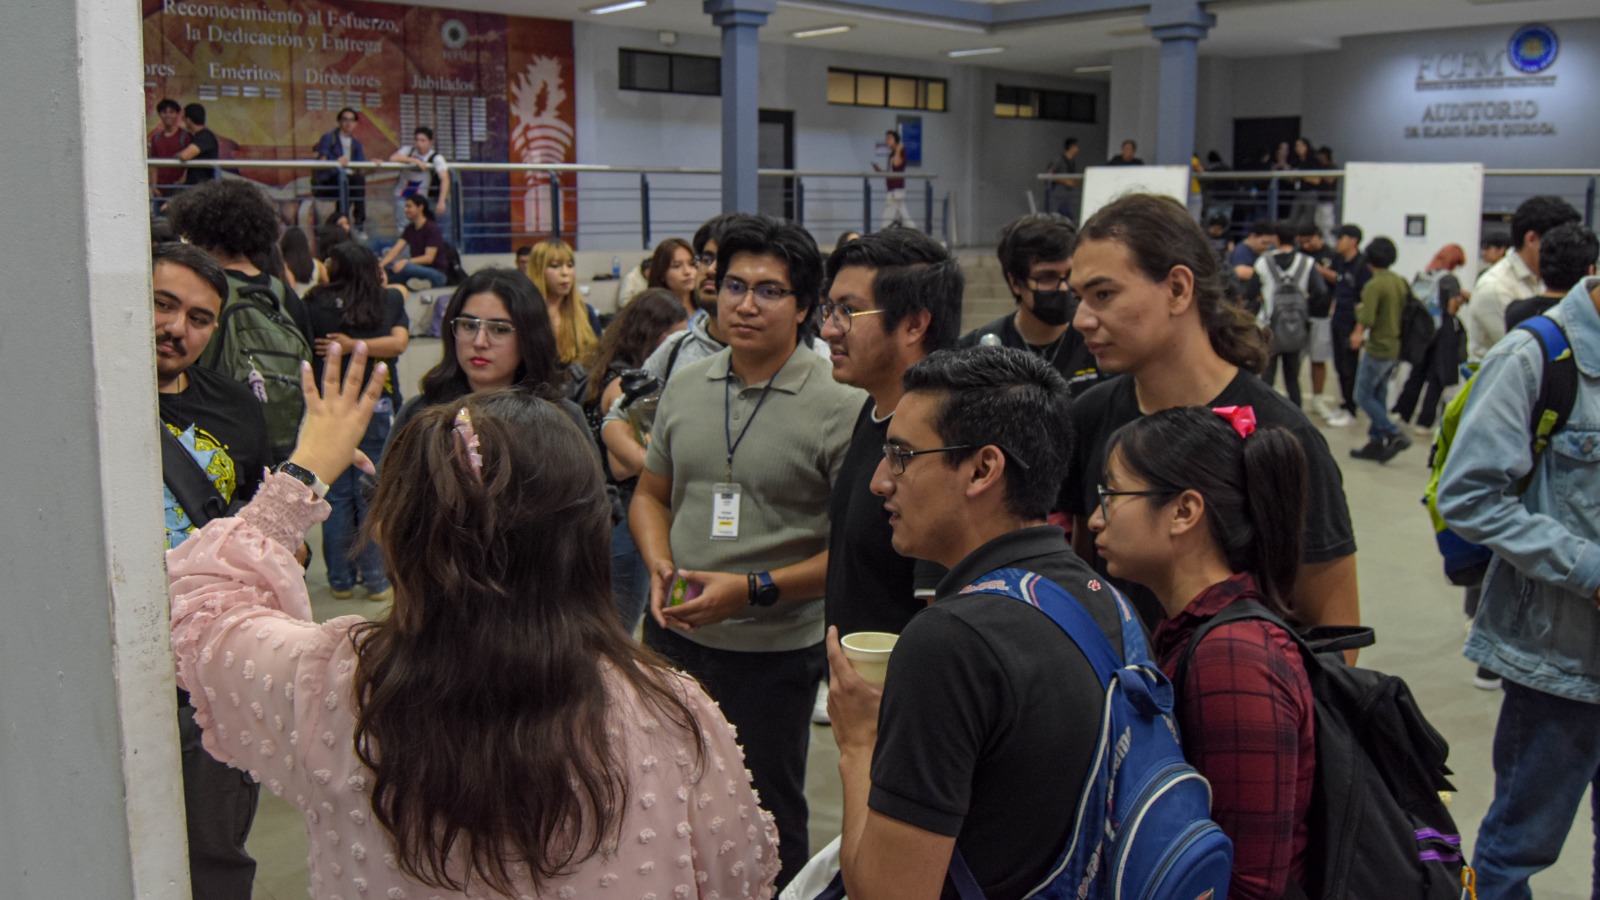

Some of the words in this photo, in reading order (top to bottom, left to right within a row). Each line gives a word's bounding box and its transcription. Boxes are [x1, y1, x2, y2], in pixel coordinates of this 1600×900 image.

[163, 0, 303, 24] Reconocimiento
[307, 10, 321, 25] al
[327, 10, 399, 33] Esfuerzo,
[185, 22, 200, 41] la
[208, 25, 303, 48] Dedicación
[308, 36, 320, 52] y
[322, 33, 382, 57] Entrega
[209, 62, 280, 80] Eméritos
[1415, 50, 1507, 81] FCFM
[305, 68, 381, 88] Directores
[411, 74, 475, 92] Jubilados
[1421, 100, 1539, 123] AUDITORIO
